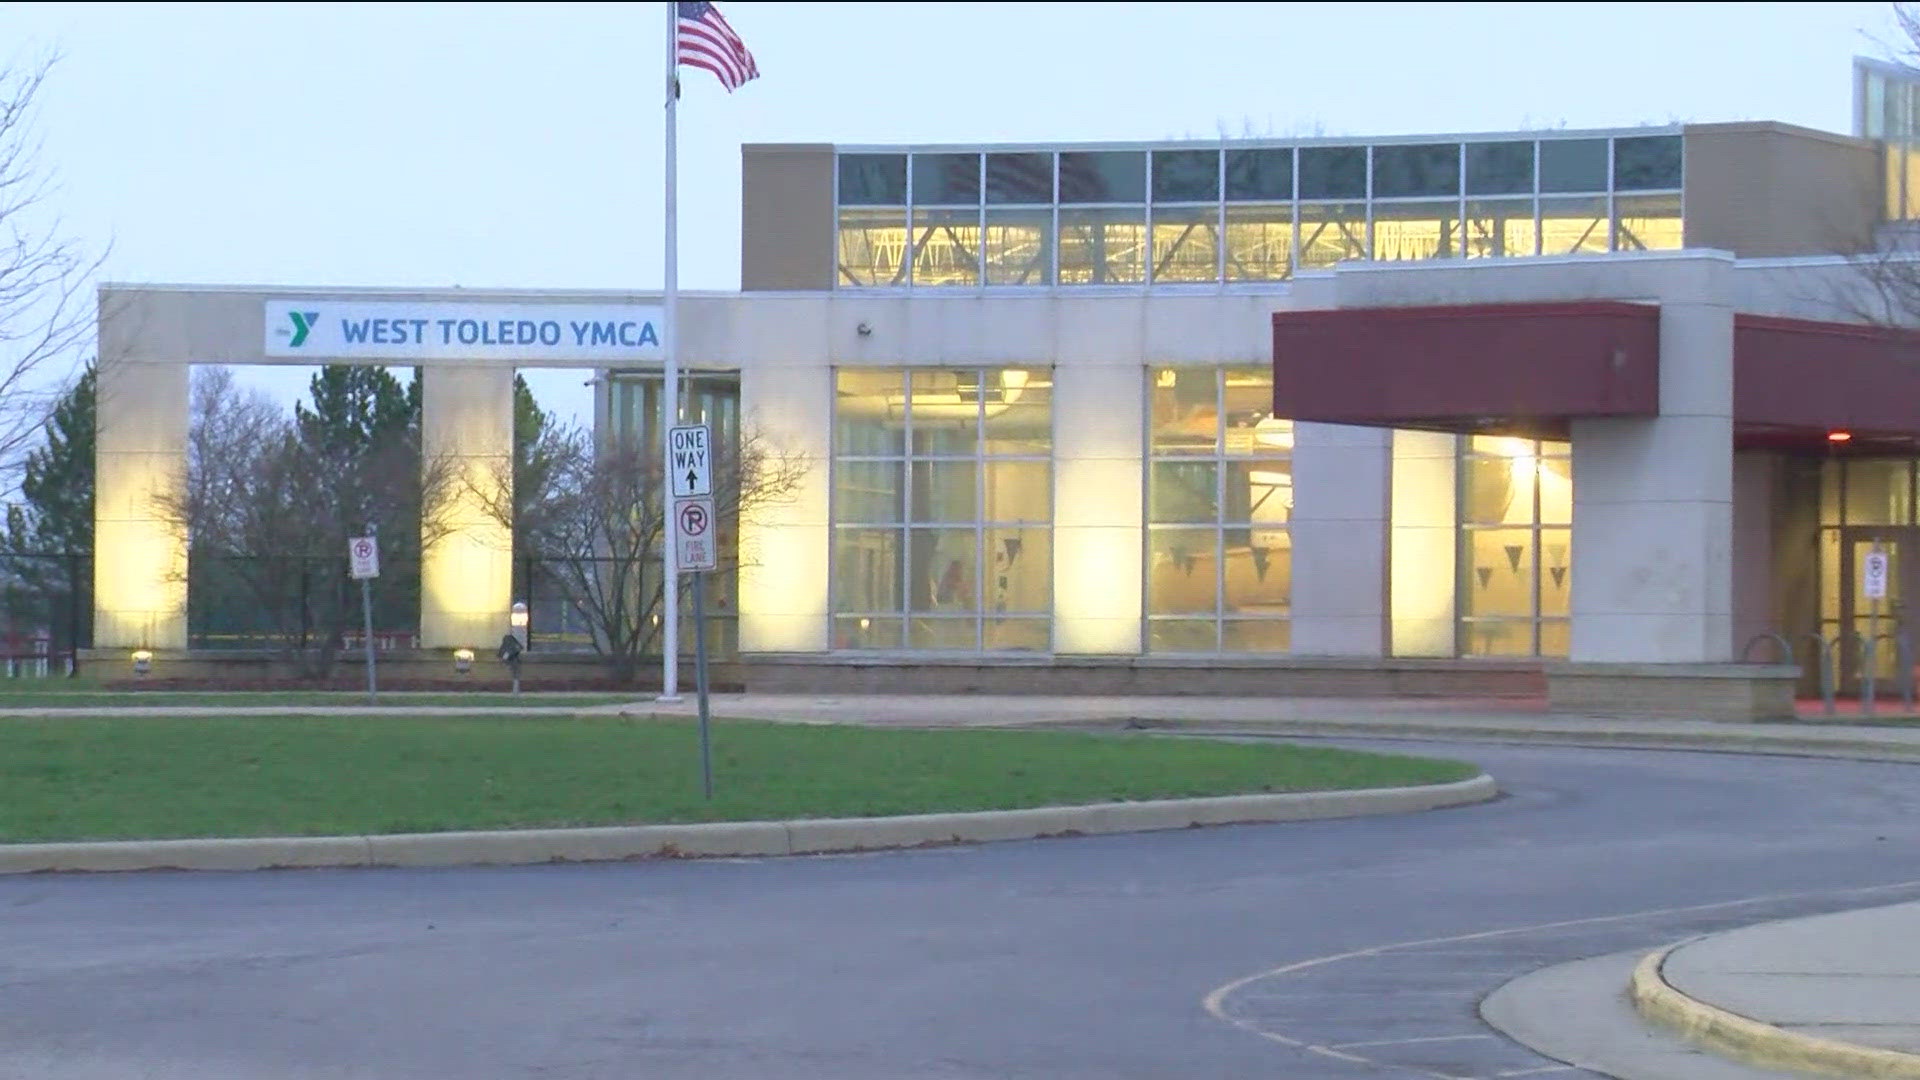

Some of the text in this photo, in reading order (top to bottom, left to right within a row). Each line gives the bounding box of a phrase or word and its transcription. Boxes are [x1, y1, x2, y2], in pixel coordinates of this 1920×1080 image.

[341, 319, 659, 346] WEST TOLEDO YMCA
[675, 431, 704, 449] ONE
[675, 451, 705, 469] WAY
